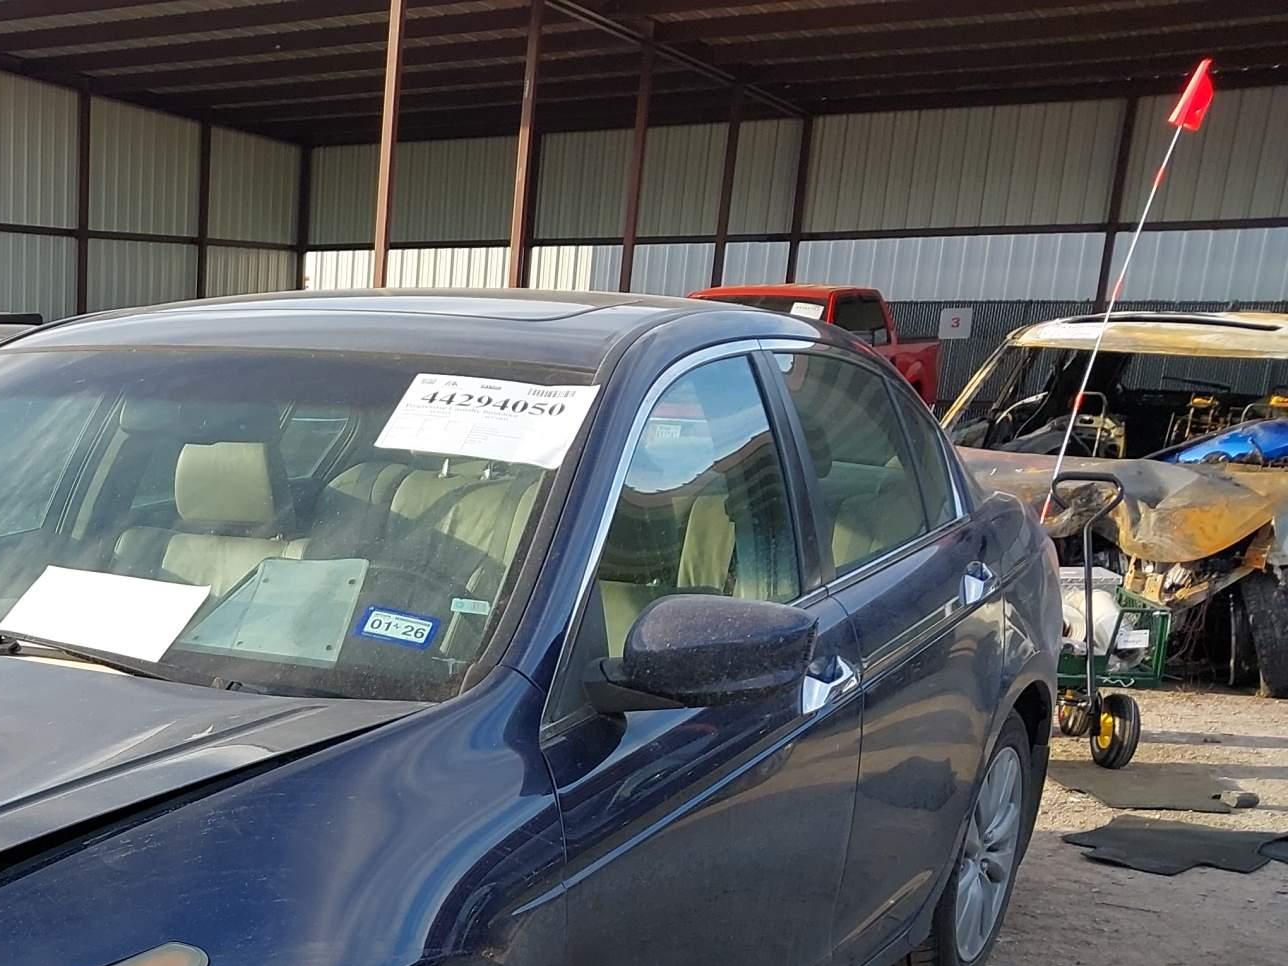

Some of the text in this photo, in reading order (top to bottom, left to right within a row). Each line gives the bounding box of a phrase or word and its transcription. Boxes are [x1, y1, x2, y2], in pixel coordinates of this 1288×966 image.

[950, 317, 961, 328] 3
[420, 391, 566, 417] 44294050
[370, 618, 392, 632] 01
[401, 624, 427, 639] 26
